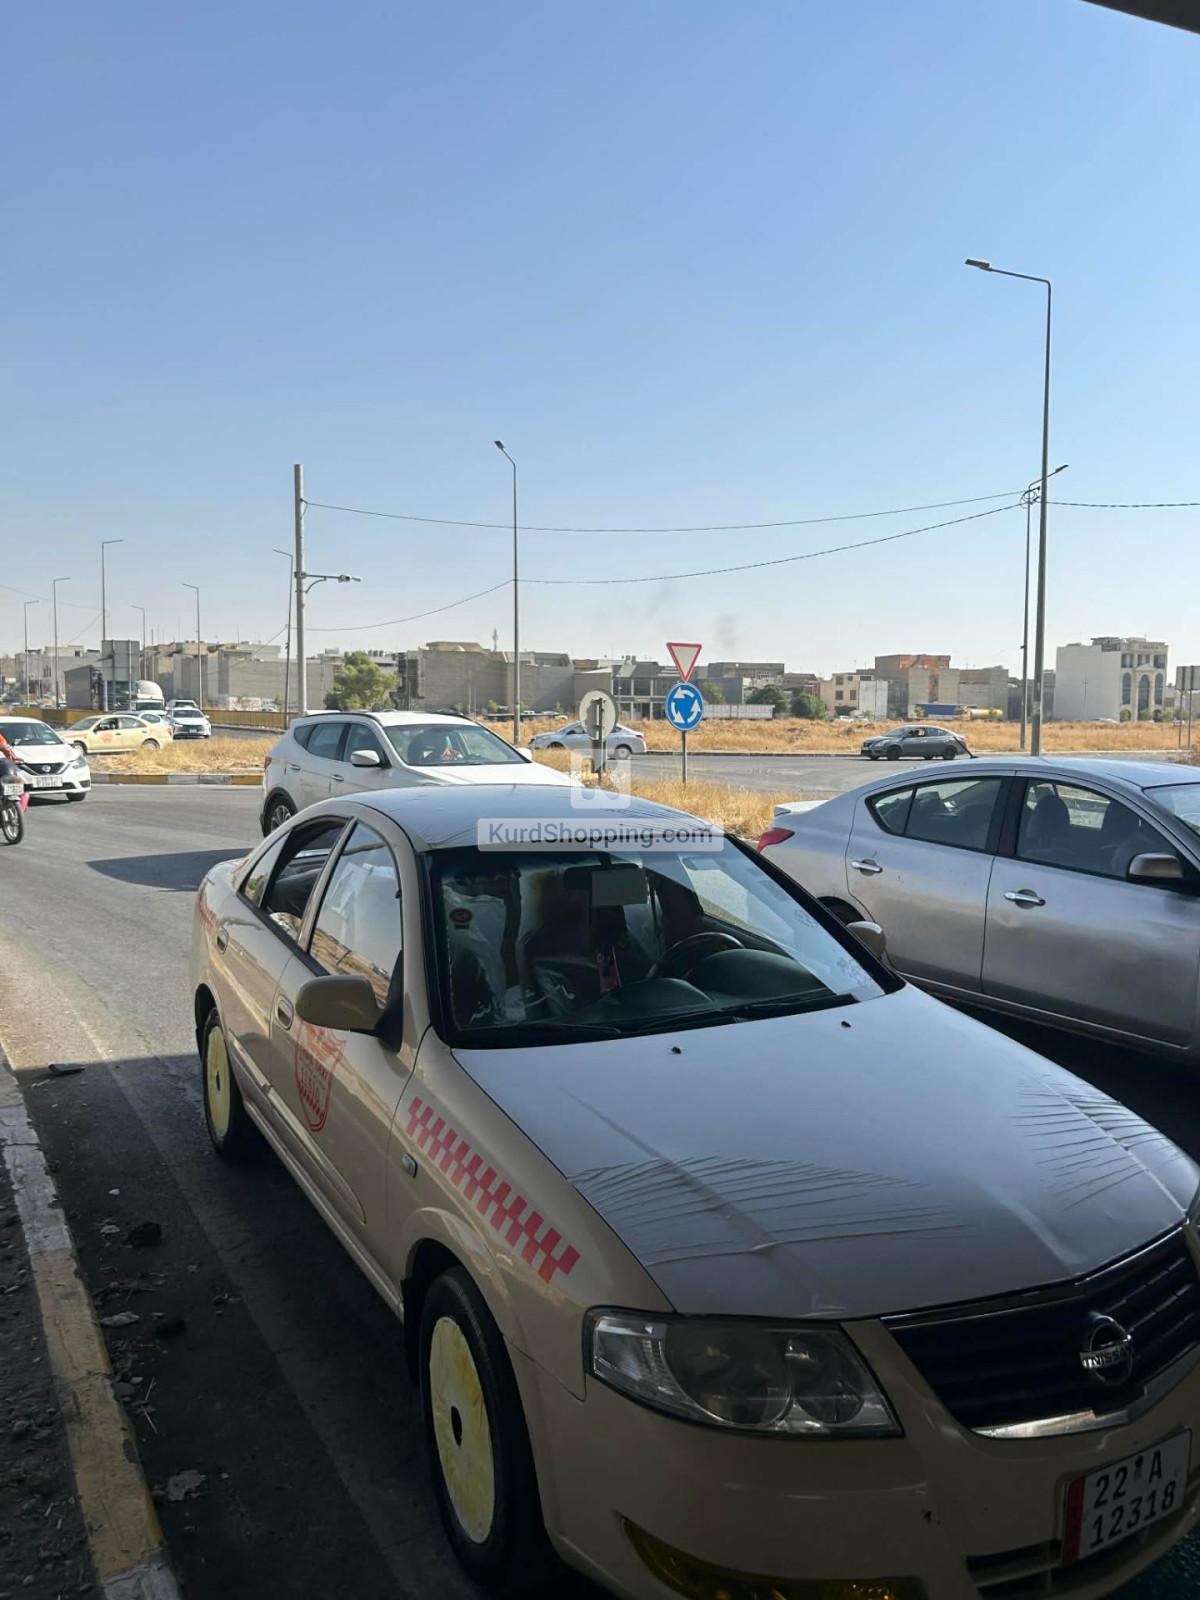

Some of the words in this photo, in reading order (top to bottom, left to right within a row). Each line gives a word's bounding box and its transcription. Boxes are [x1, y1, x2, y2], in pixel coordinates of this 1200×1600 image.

[1093, 1466, 1129, 1510] 22
[1148, 1449, 1163, 1483] A
[1090, 1479, 1177, 1548] 12318
